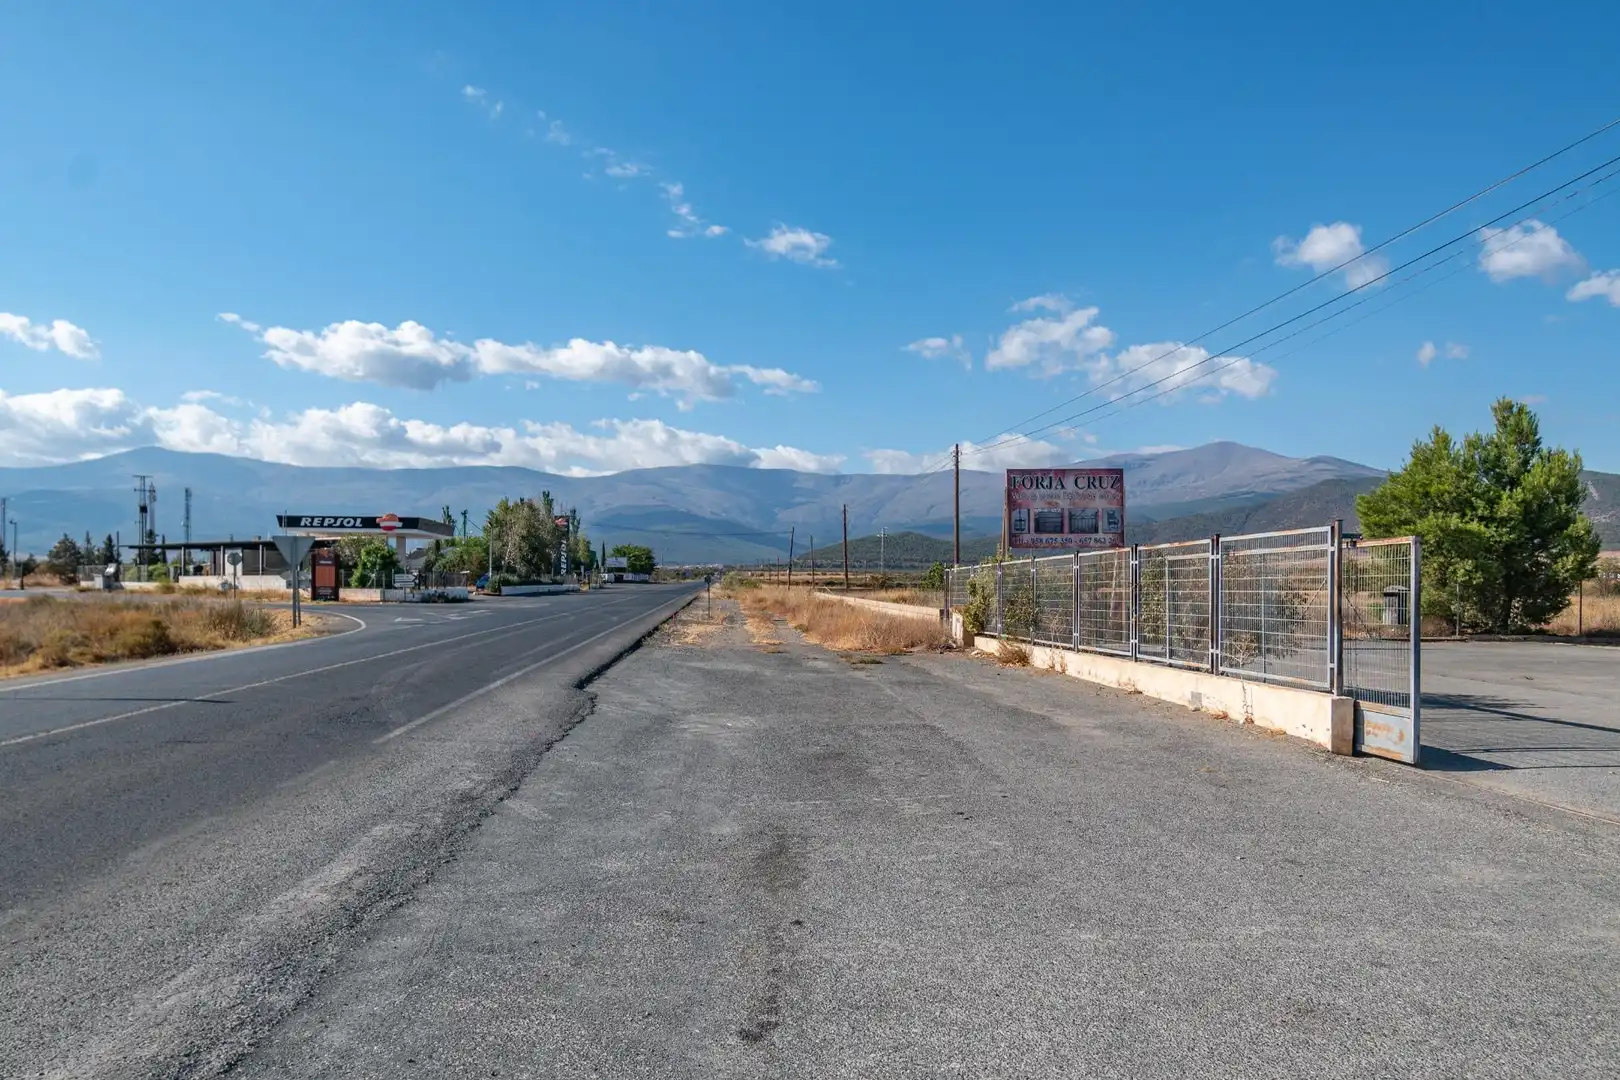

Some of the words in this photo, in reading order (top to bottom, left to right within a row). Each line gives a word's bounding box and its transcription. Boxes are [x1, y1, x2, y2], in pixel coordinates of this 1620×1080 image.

[1012, 475, 1066, 490] FORJA
[1074, 475, 1121, 490] CRUZ
[300, 517, 363, 527] REPSOL
